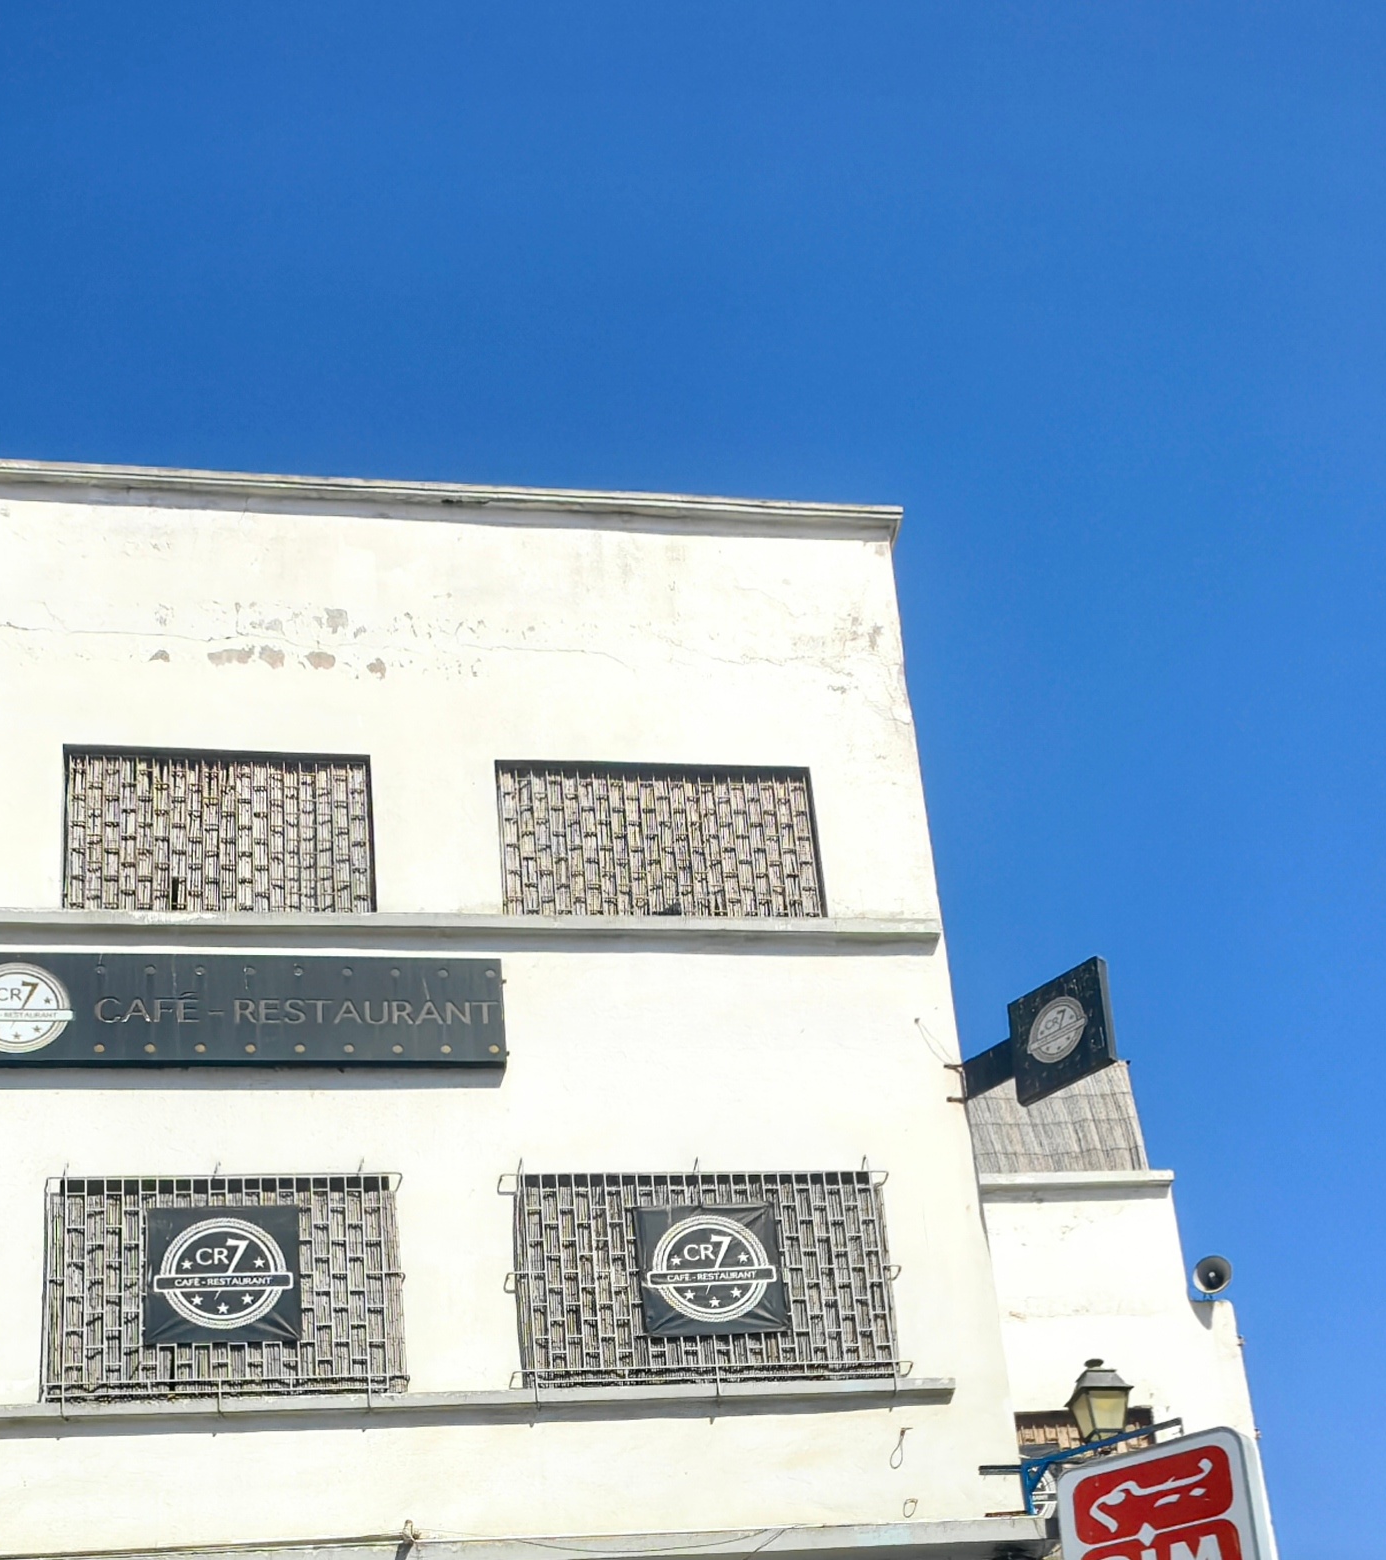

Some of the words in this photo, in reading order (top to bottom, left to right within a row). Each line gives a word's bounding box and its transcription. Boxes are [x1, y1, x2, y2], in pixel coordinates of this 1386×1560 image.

[94, 991, 201, 1024] CAFÉ
[232, 999, 500, 1026] RESTAURANT
[1044, 1008, 1067, 1031] CR7
[195, 1237, 251, 1274] CR7
[683, 1234, 734, 1269] CR7
[207, 1276, 273, 1286] RESTAURANT
[697, 1270, 758, 1281] RESTAURANT
